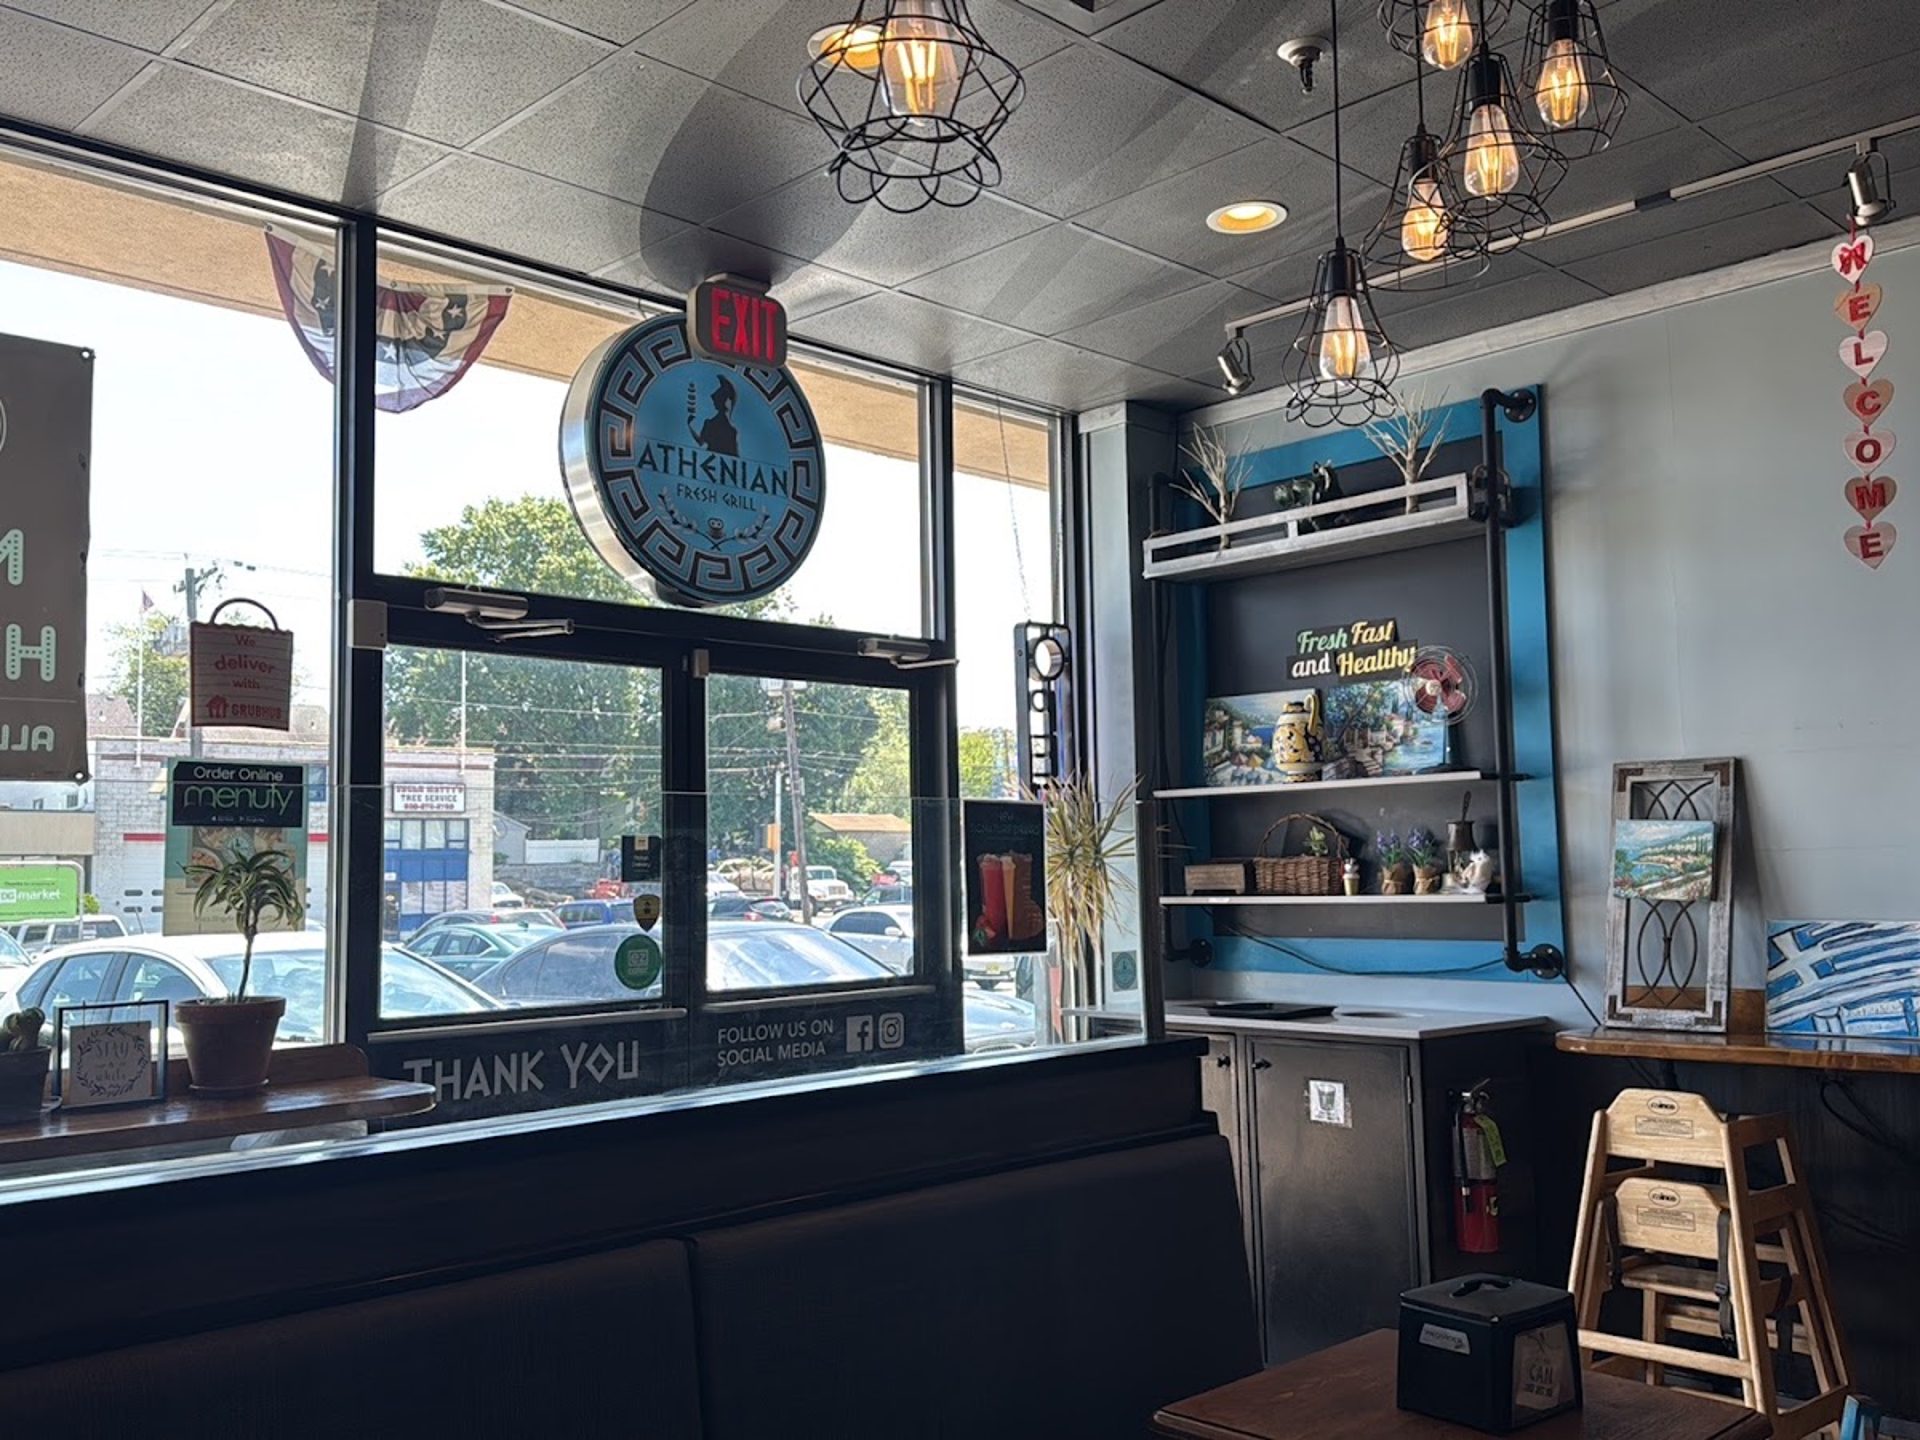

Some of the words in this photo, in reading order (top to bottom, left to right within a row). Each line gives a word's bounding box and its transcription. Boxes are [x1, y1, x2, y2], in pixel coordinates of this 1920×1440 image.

[711, 288, 777, 361] EXIT
[1838, 242, 1886, 559] WELCOME
[638, 443, 788, 498] ATHENIAN
[676, 482, 718, 504] FRESH
[722, 493, 757, 512] GRILL
[234, 634, 256, 647] We
[1297, 629, 1347, 653] Fresh
[1351, 620, 1394, 645] Fast
[214, 654, 275, 674] deliver
[1292, 653, 1331, 678] and
[1336, 645, 1416, 677] Healthy
[231, 678, 260, 690] with
[231, 703, 282, 719] GRUBHUB
[193, 765, 234, 780] Order
[238, 767, 284, 782] Online
[717, 1025, 784, 1045] FOLLOW
[787, 1022, 807, 1039] US
[811, 1018, 834, 1036] ON
[717, 1047, 773, 1068] SOCIAL
[777, 1040, 826, 1061] MEDIA
[403, 1050, 544, 1102] THANK
[560, 1040, 640, 1089] YOU
